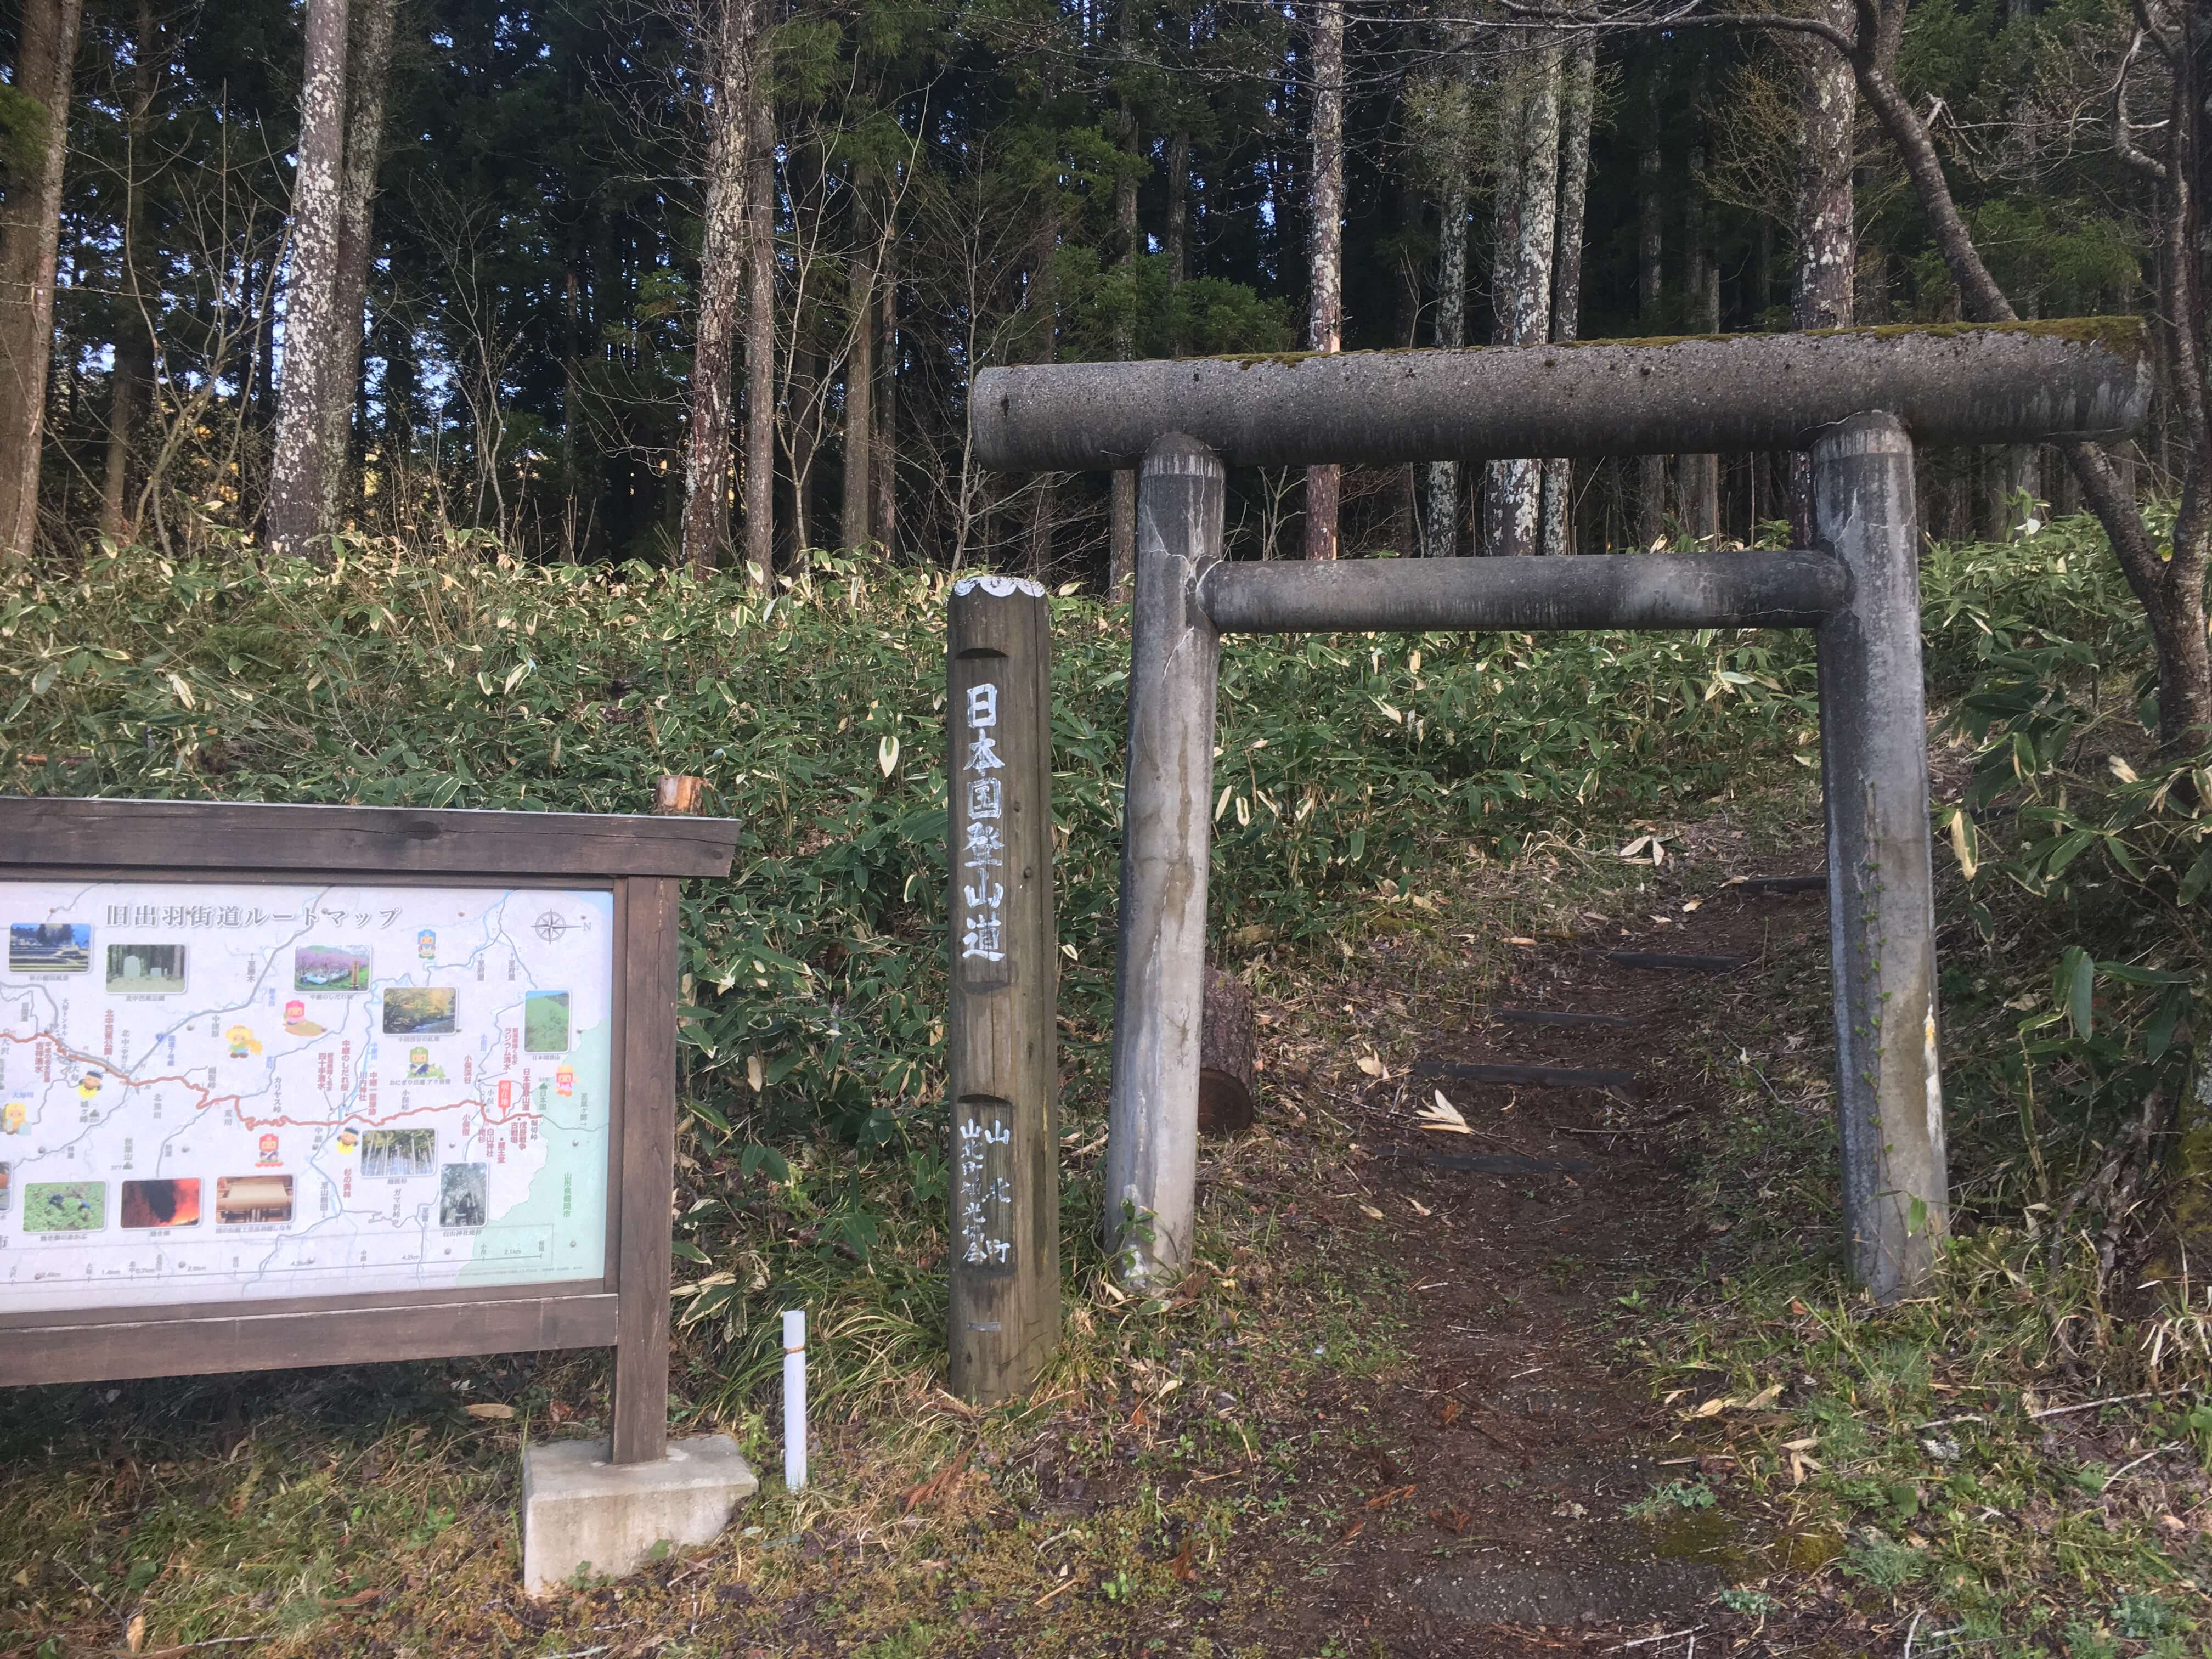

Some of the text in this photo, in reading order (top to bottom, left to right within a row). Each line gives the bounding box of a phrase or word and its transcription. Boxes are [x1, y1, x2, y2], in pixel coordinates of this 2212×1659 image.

[962, 682, 1006, 962] 日本国登山道
[107, 905, 401, 927] 旧出羽街道ルートマップ
[583, 922, 591, 931] N
[960, 1118, 987, 1264] 山北町観光協会
[984, 1119, 1011, 1264] 山北町
